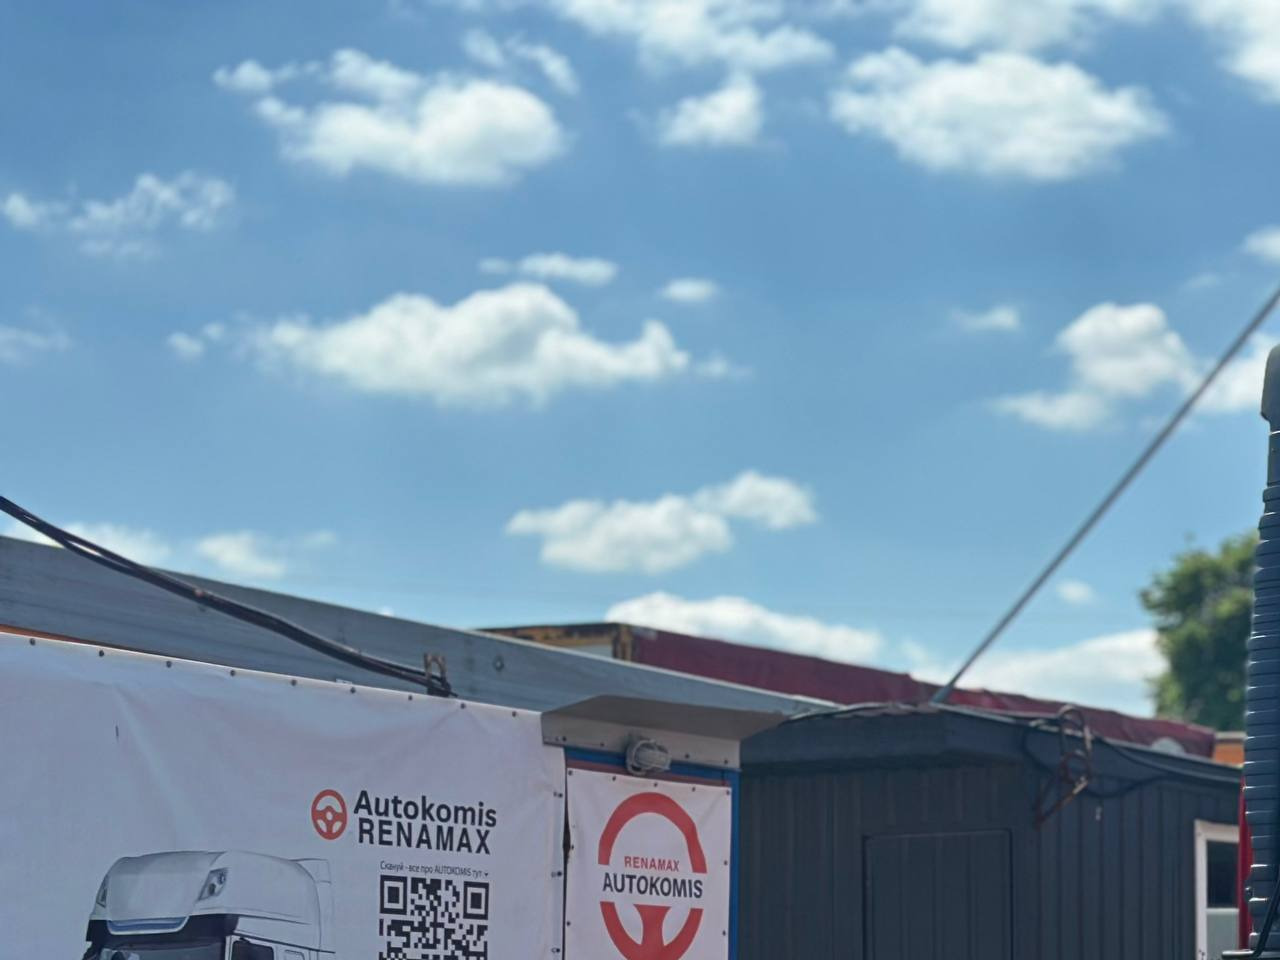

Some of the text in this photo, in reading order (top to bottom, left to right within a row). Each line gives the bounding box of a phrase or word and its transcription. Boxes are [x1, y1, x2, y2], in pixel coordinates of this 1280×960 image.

[353, 790, 497, 827] Autokomis
[358, 817, 491, 854] RENAMAX
[624, 856, 680, 872] RENAMAX
[602, 872, 703, 898] AUTOKOMIS
